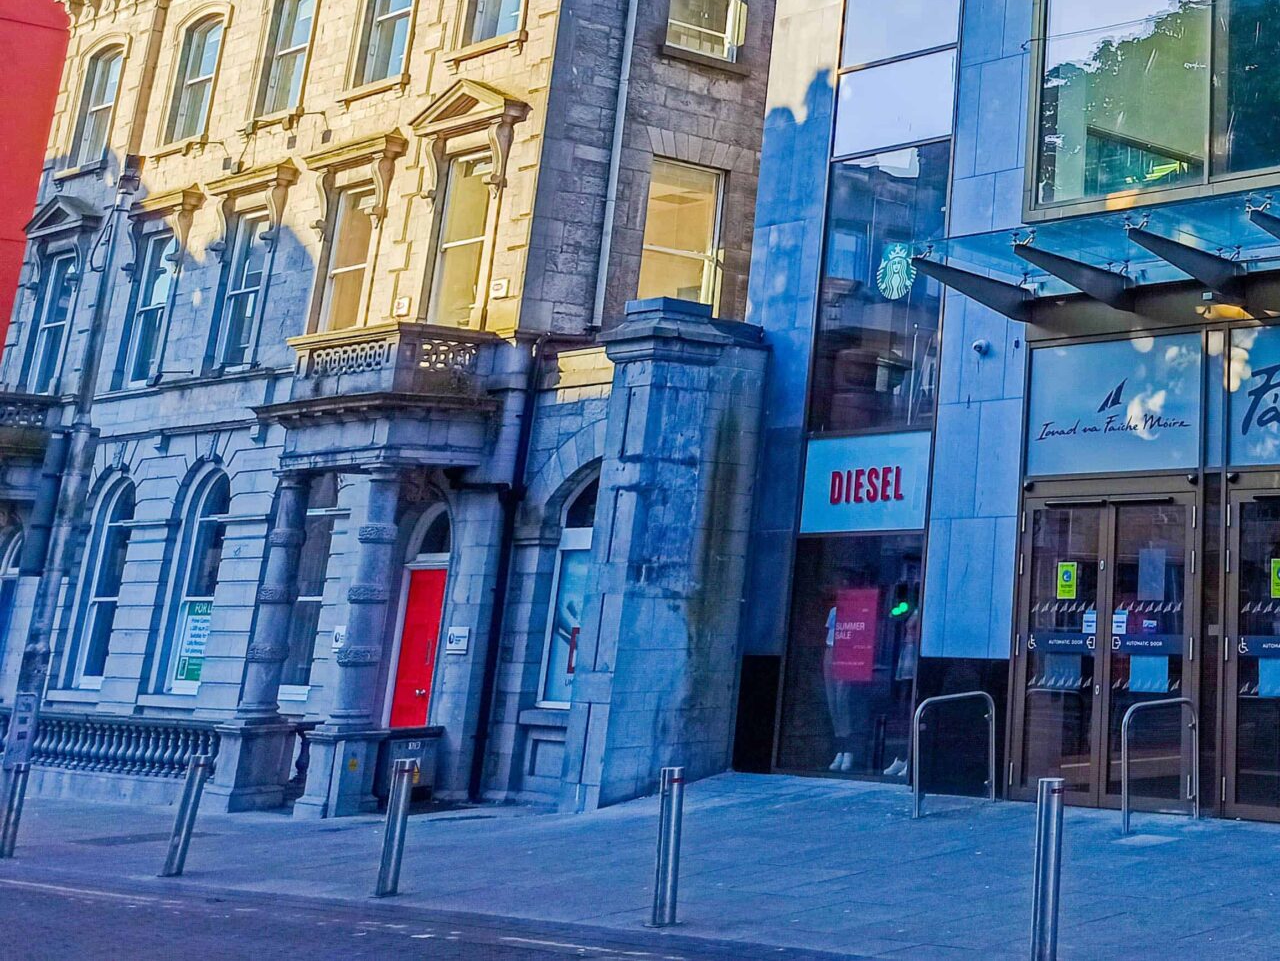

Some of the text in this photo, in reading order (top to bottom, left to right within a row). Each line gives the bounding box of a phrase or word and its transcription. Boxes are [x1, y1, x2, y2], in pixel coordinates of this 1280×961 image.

[829, 465, 904, 505] DIESEL
[194, 603, 207, 613] FOR
[835, 622, 865, 631] SUMMER
[835, 631, 852, 639] SALE
